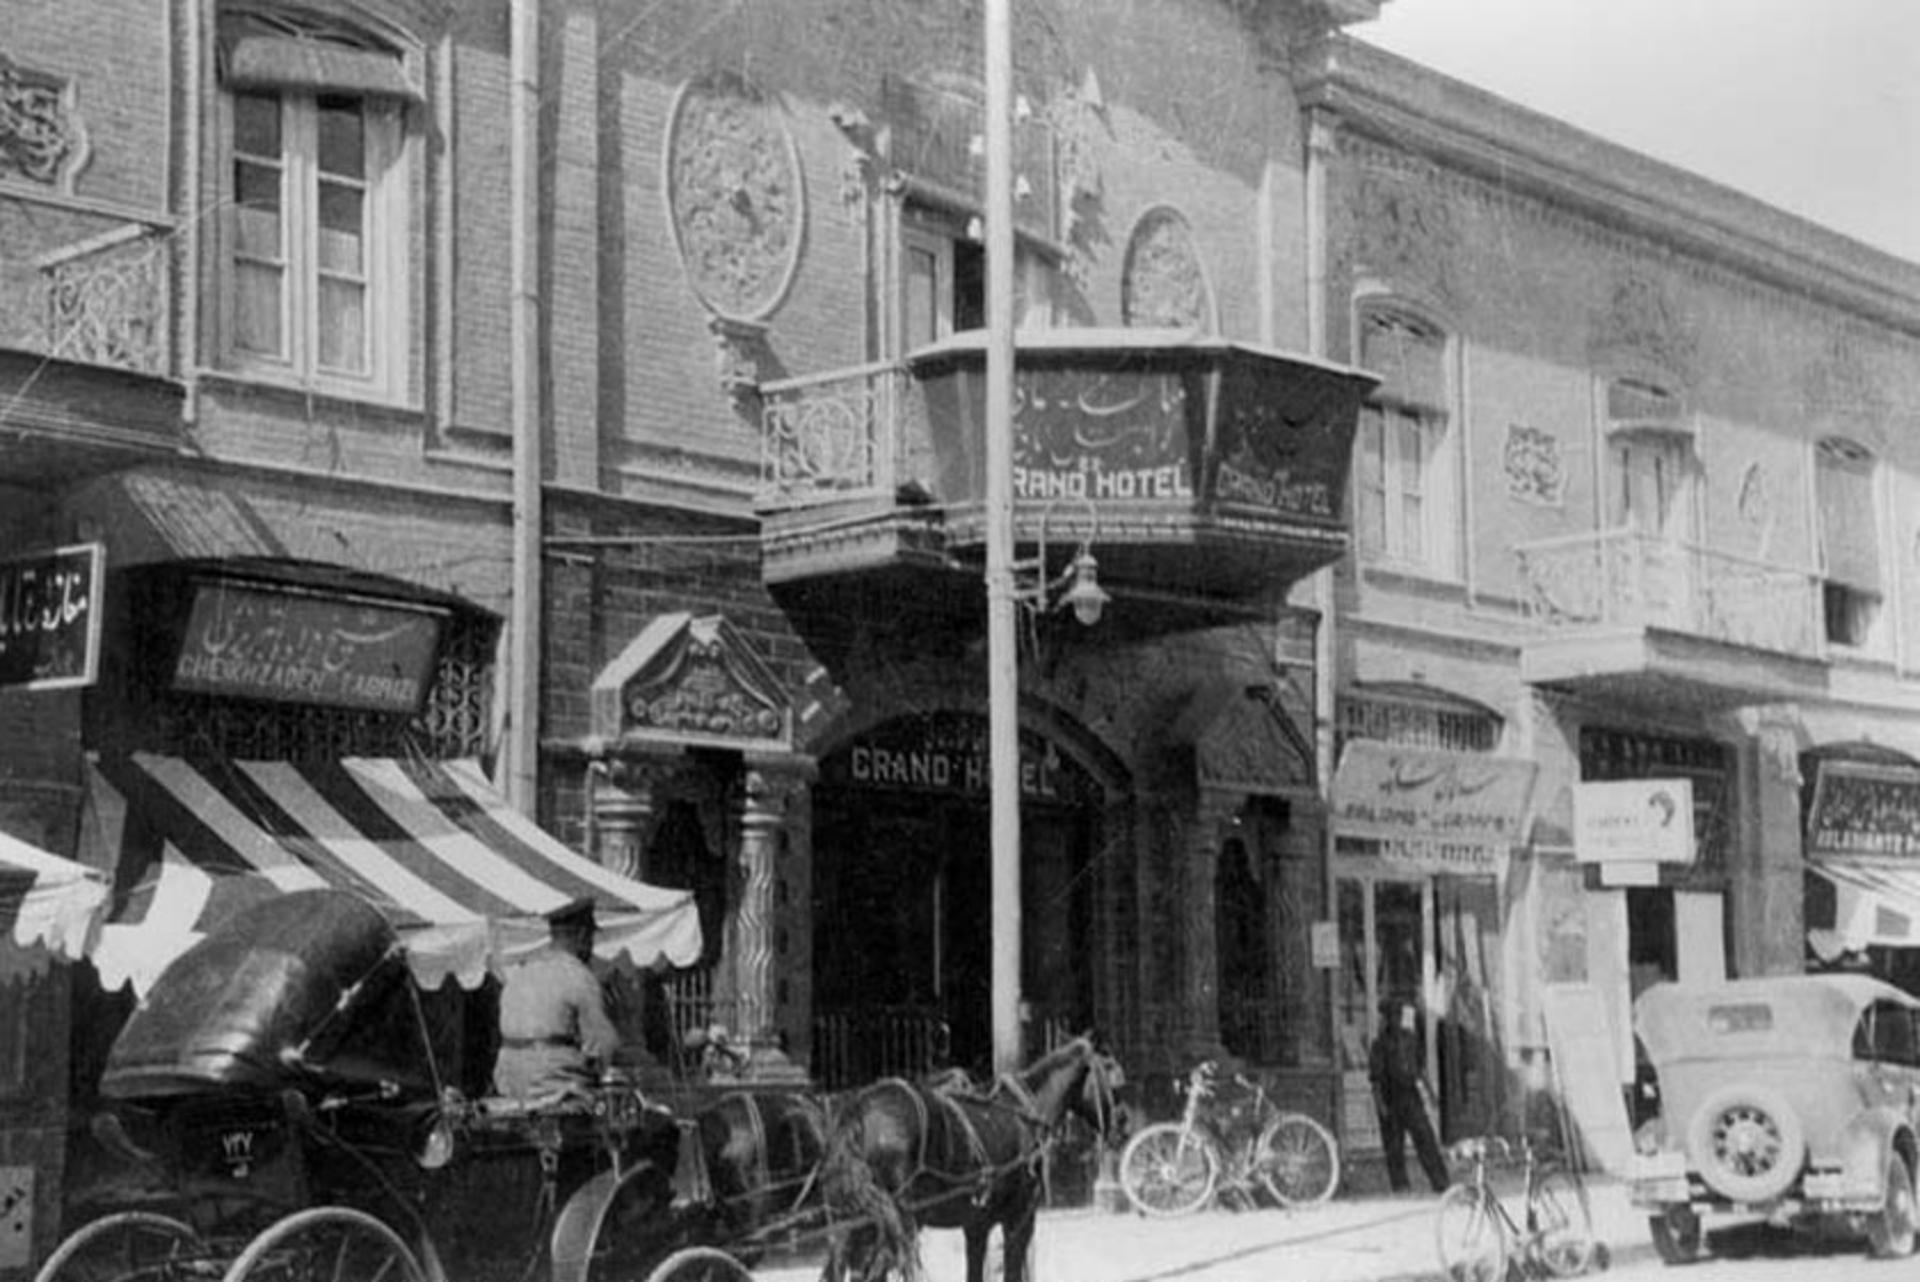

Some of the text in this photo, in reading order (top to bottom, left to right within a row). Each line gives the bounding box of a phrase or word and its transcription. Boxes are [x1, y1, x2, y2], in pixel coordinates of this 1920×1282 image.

[1013, 467, 1086, 497] RAND
[1097, 464, 1193, 497] HOTEL
[851, 746, 1056, 796] GRAND HEL
